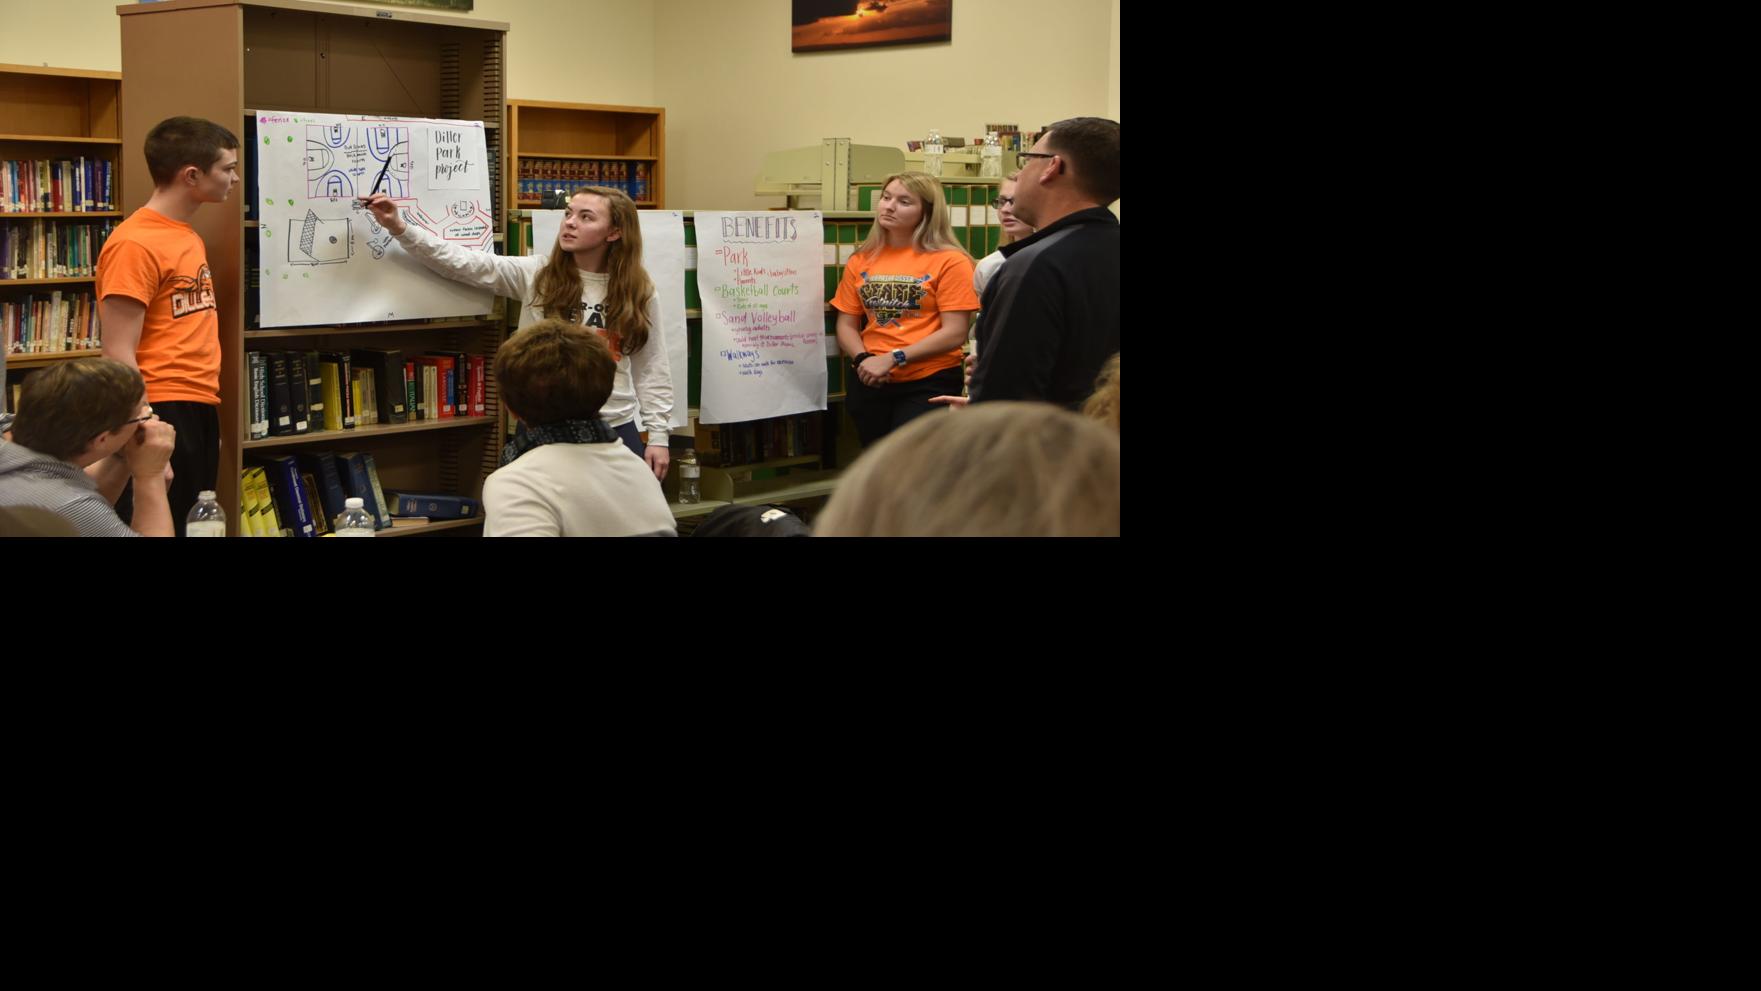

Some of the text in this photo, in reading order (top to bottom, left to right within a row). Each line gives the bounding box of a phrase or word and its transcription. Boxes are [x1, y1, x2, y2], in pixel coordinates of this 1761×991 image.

[435, 130, 461, 144] Diller
[435, 160, 475, 181] project
[721, 216, 798, 240] BENEFITS
[723, 246, 748, 266] Park
[722, 284, 768, 298] Basketball
[721, 310, 796, 326] Sand Volleyball
